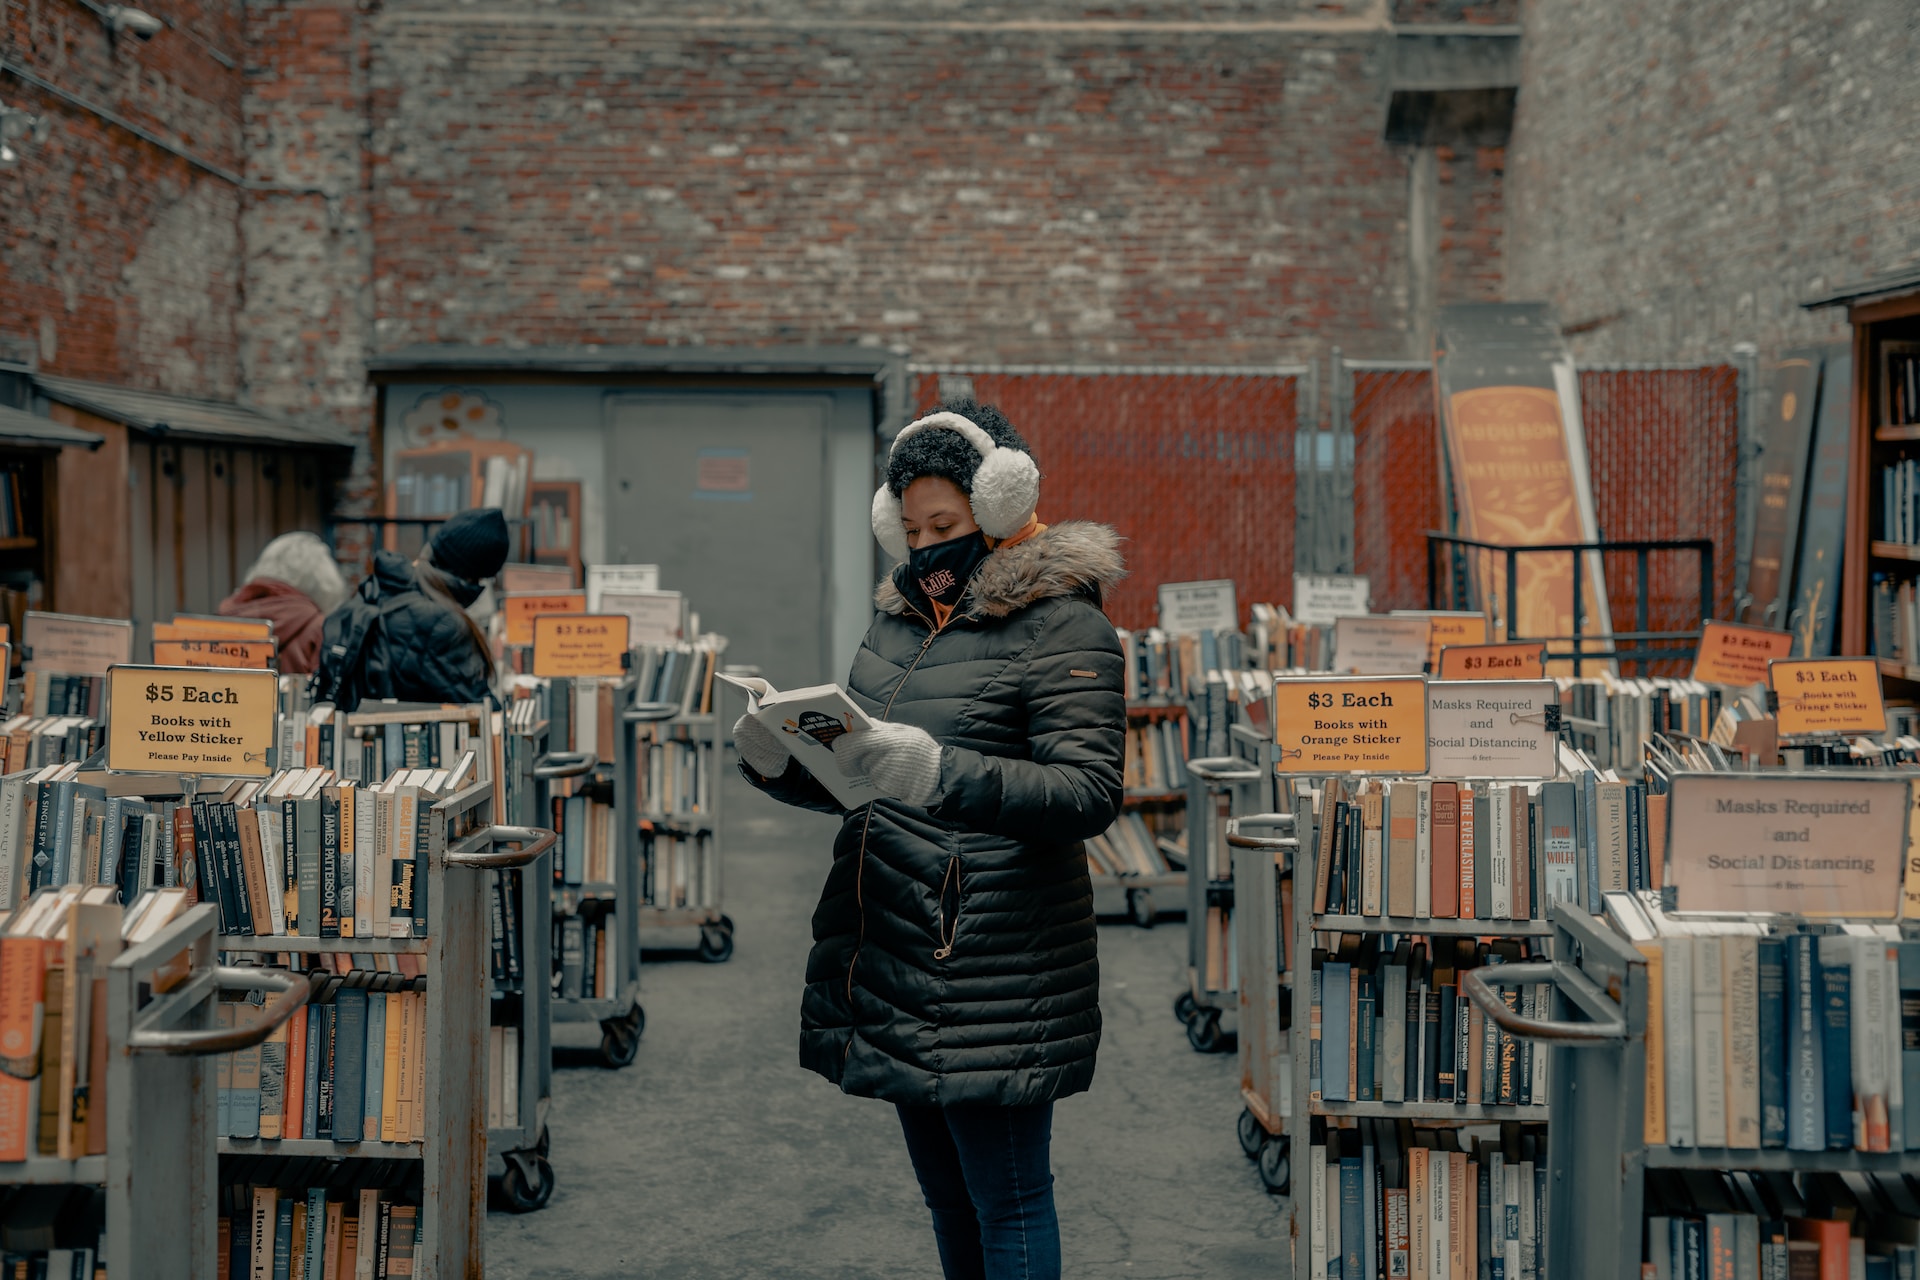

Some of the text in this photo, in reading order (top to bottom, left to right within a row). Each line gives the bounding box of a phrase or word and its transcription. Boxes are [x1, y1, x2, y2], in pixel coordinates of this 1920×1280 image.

[209, 641, 249, 658] Each
[1464, 655, 1522, 670] $3 Each
[1796, 670, 1857, 683] $3 Each
[146, 683, 239, 704] $5 Each
[1308, 692, 1393, 710] $3 Each
[1432, 699, 1532, 712] Masks Required
[1795, 702, 1867, 712] Orange Sticker
[151, 715, 231, 728] Books with
[1314, 720, 1387, 729] Books with
[1470, 718, 1493, 728] and
[139, 731, 243, 744] Yellow Sticker
[1301, 734, 1401, 746] Orange Sticker
[1429, 737, 1537, 750] Social Distancing
[149, 752, 232, 763] Please Pay Inside
[40, 800, 49, 830] SINGLE
[286, 803, 292, 813] AS
[1716, 799, 1870, 818] Masks Required
[1, 793, 14, 858] FIRST SALUTE
[364, 798, 373, 844] JUDITH
[399, 796, 412, 859] OSCAR LEWIS
[1552, 826, 1570, 838] TOM
[38, 832, 46, 847] SPY
[107, 826, 115, 855] NOONAN
[1462, 798, 1473, 889] THE EVERLASTING
[1610, 802, 1620, 867] THE VANTAGE
[1773, 828, 1810, 842] and
[104, 858, 112, 881] SIMPLY
[323, 814, 335, 906] JAMES PATTERSON
[1368, 837, 1376, 896] Aristotle's Children
[1547, 852, 1575, 864] WOLFE
[1708, 855, 1874, 873] Social Distancing
[206, 860, 214, 887] Sandpipers
[235, 865, 243, 885] Warblers
[391, 885, 402, 908] Essays
[398, 863, 414, 910] Anthropological
[1732, 970, 1742, 1014] WILLIAM
[1801, 982, 1811, 1008] OF THE
[1867, 969, 1880, 1023] MISMATCH
[1740, 950, 1755, 1089] NORTHWEST PASSAGE
[1486, 1034, 1495, 1070] OF FISHES
[1800, 1049, 1815, 1144] MICHIO KAKU
[1450, 1162, 1458, 1190] THUNDER
[1450, 1191, 1458, 1200] AT
[383, 1204, 389, 1214] AS
[1398, 1195, 1407, 1236] CAMPING
[256, 1210, 265, 1253] House
[307, 1215, 315, 1253] Political
[381, 1216, 389, 1244] UNIONS
[1388, 1196, 1398, 1249] WOODCRAFT
